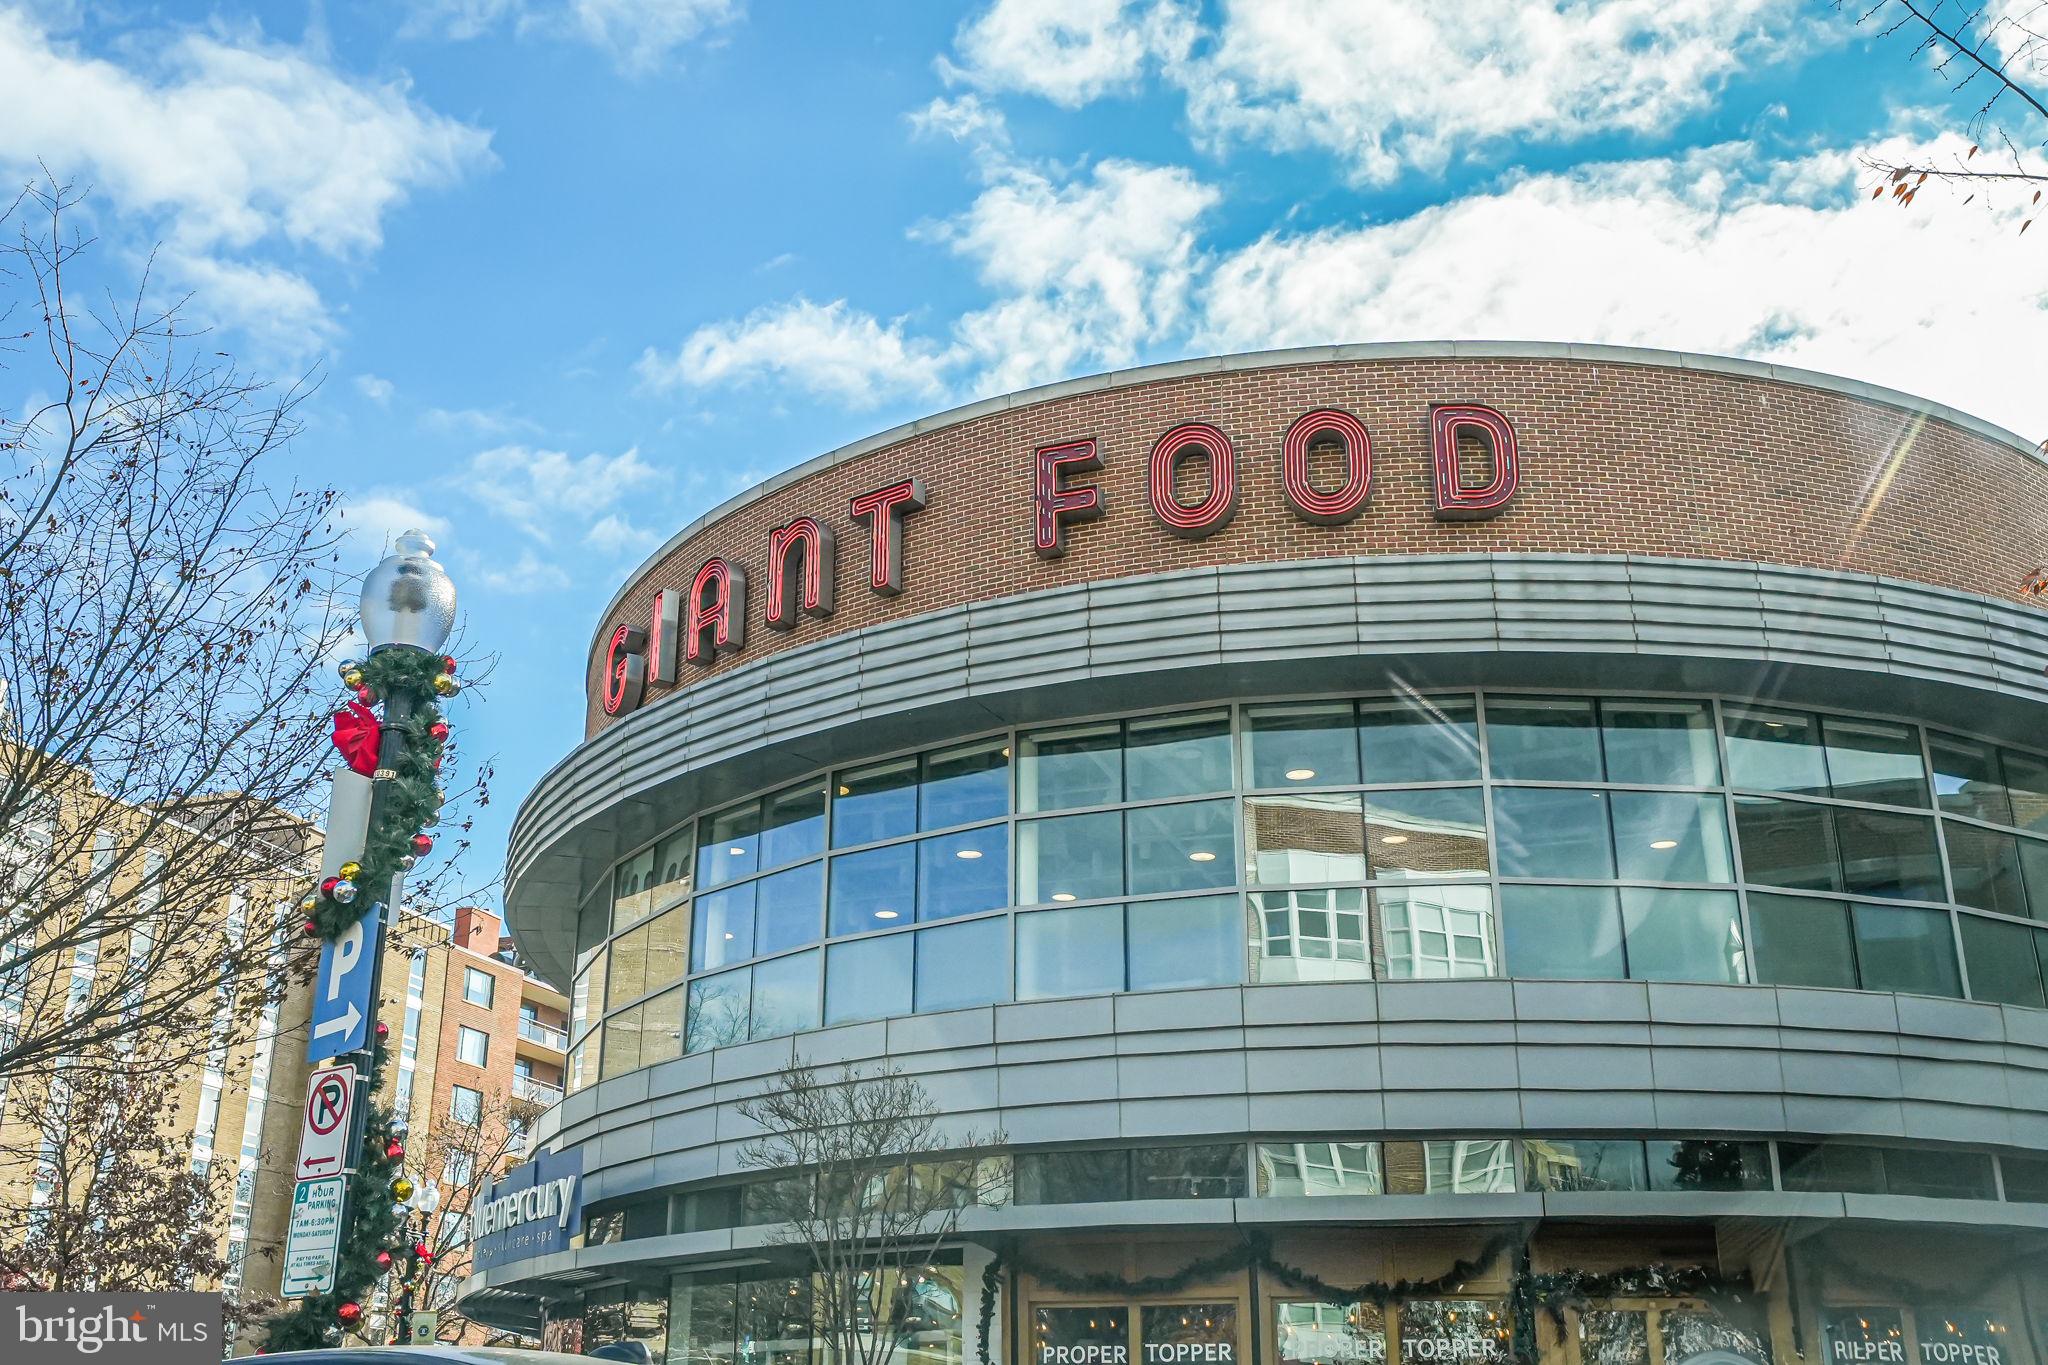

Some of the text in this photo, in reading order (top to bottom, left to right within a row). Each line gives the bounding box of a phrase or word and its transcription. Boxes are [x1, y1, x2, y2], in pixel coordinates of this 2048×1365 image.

[604, 403, 1521, 717] GIANT FOOD
[328, 920, 363, 1001] P
[299, 1187, 334, 1201] 2 HOUR
[308, 1199, 336, 1210] PARKING
[1043, 1343, 1232, 1364] PROPER TOPPER
[1402, 1338, 1497, 1358] TOPPER
[1921, 1342, 2001, 1365] TOPPER
